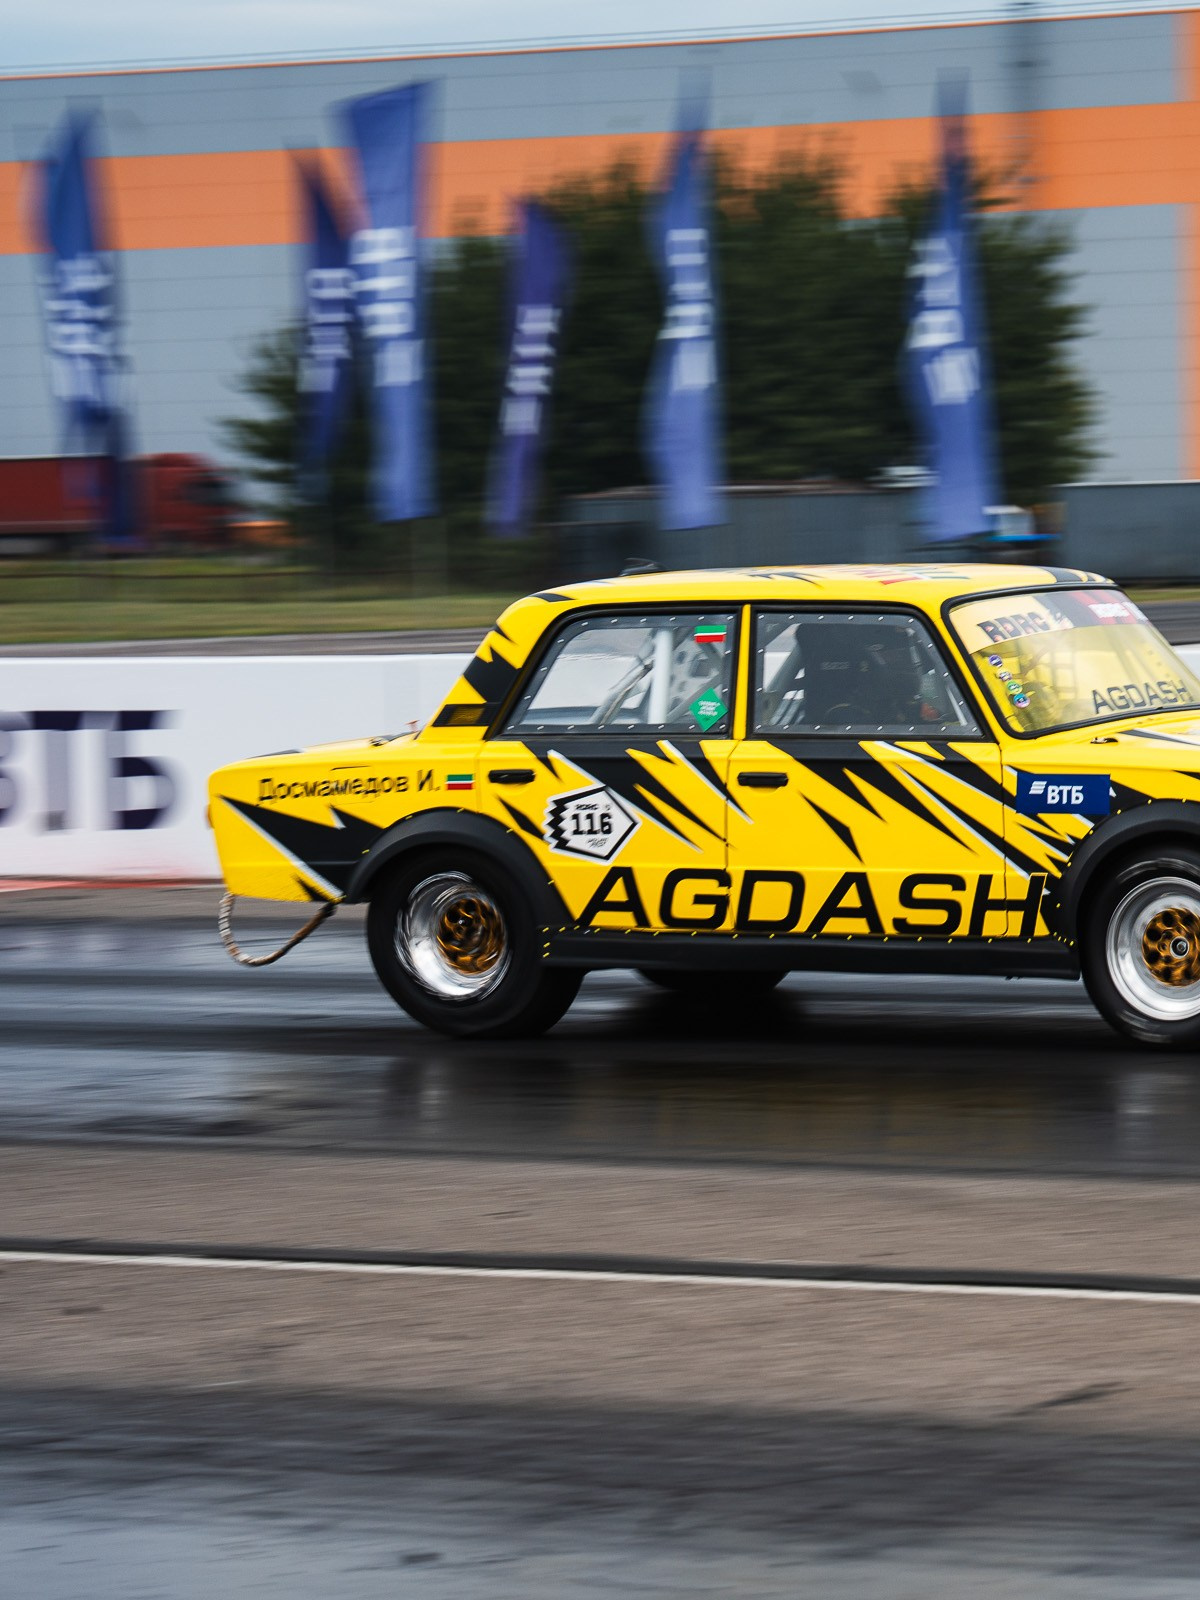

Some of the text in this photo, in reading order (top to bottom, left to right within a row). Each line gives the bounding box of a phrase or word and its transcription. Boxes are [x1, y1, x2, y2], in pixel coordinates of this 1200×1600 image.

[1092, 679, 1194, 714] AGDASH
[0, 709, 184, 831] ТБ
[258, 776, 409, 804] Досмамедов
[1046, 784, 1085, 805] ВТБ
[571, 812, 613, 836] 116
[575, 866, 1047, 936] AGDASH
